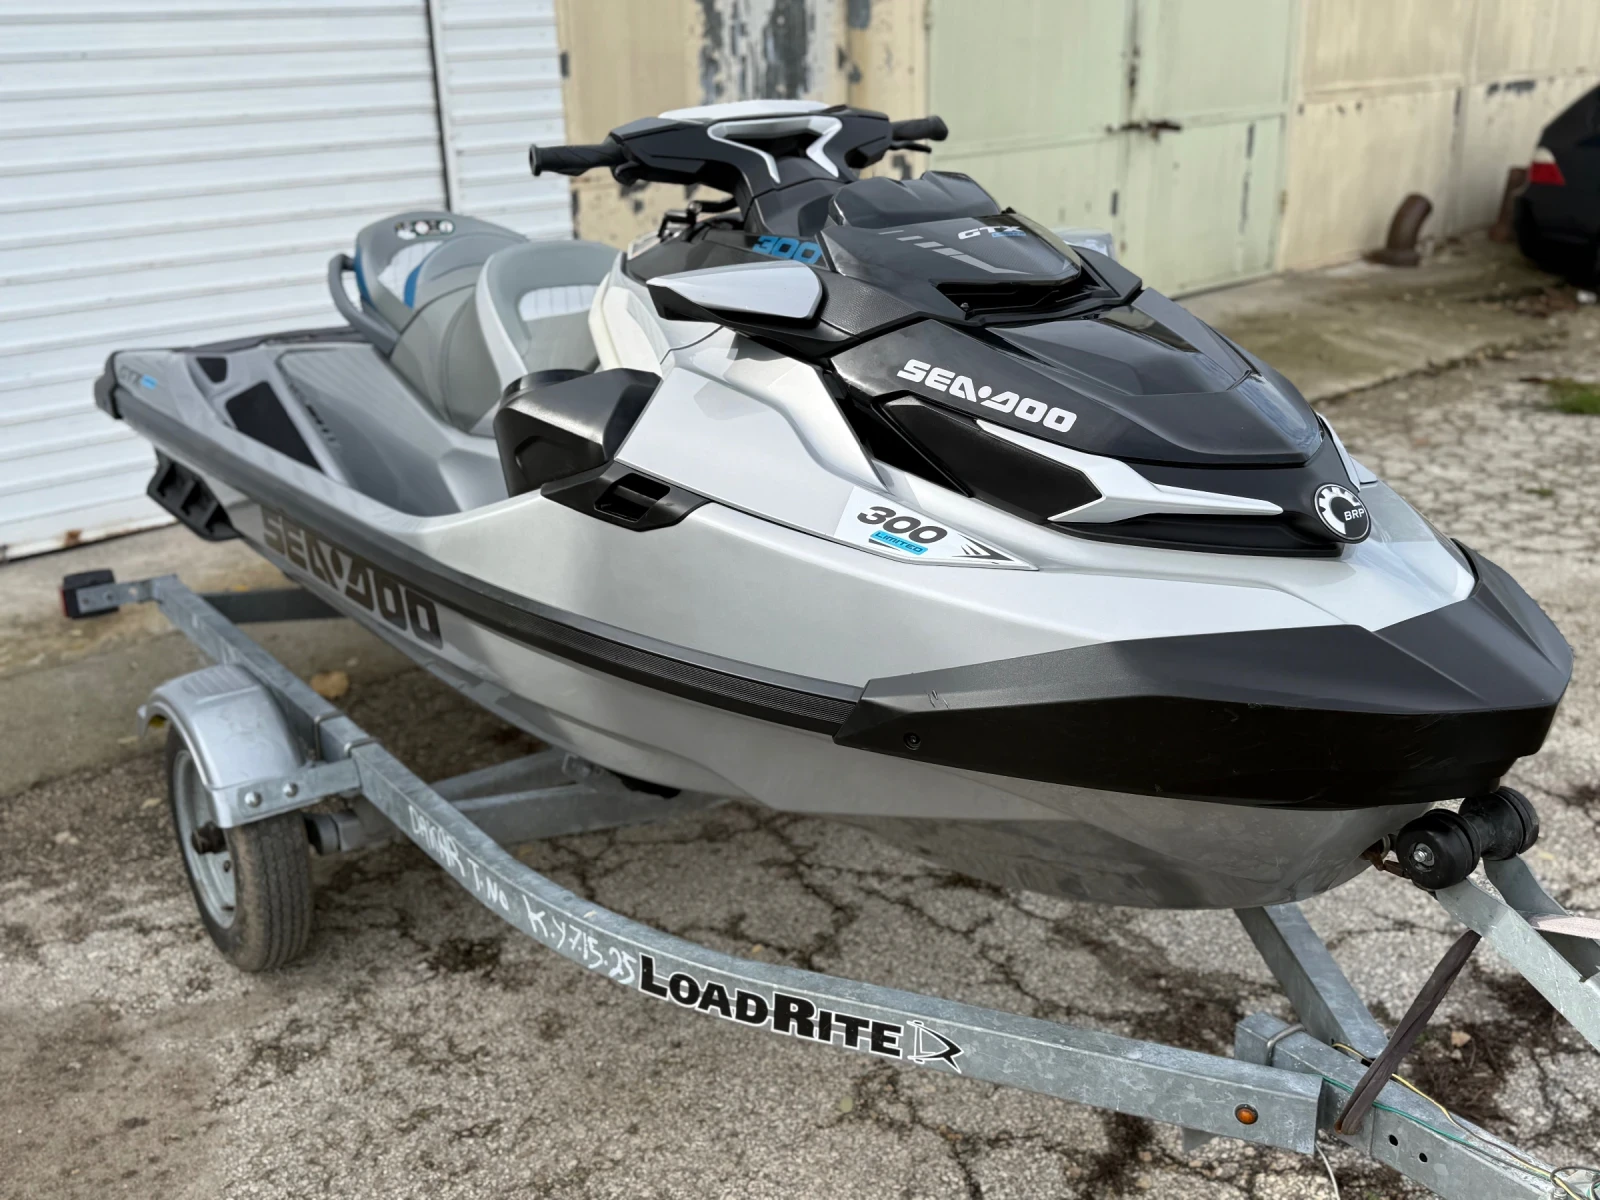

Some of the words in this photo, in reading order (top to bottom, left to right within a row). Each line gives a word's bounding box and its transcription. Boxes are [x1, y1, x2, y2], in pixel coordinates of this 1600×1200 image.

[958, 226, 1024, 239] GTX
[752, 235, 822, 265] 300
[857, 506, 948, 544] 300
[1344, 508, 1365, 521] BRP
[873, 531, 926, 553] LIMITED
[638, 952, 903, 1059] LOADRITE
